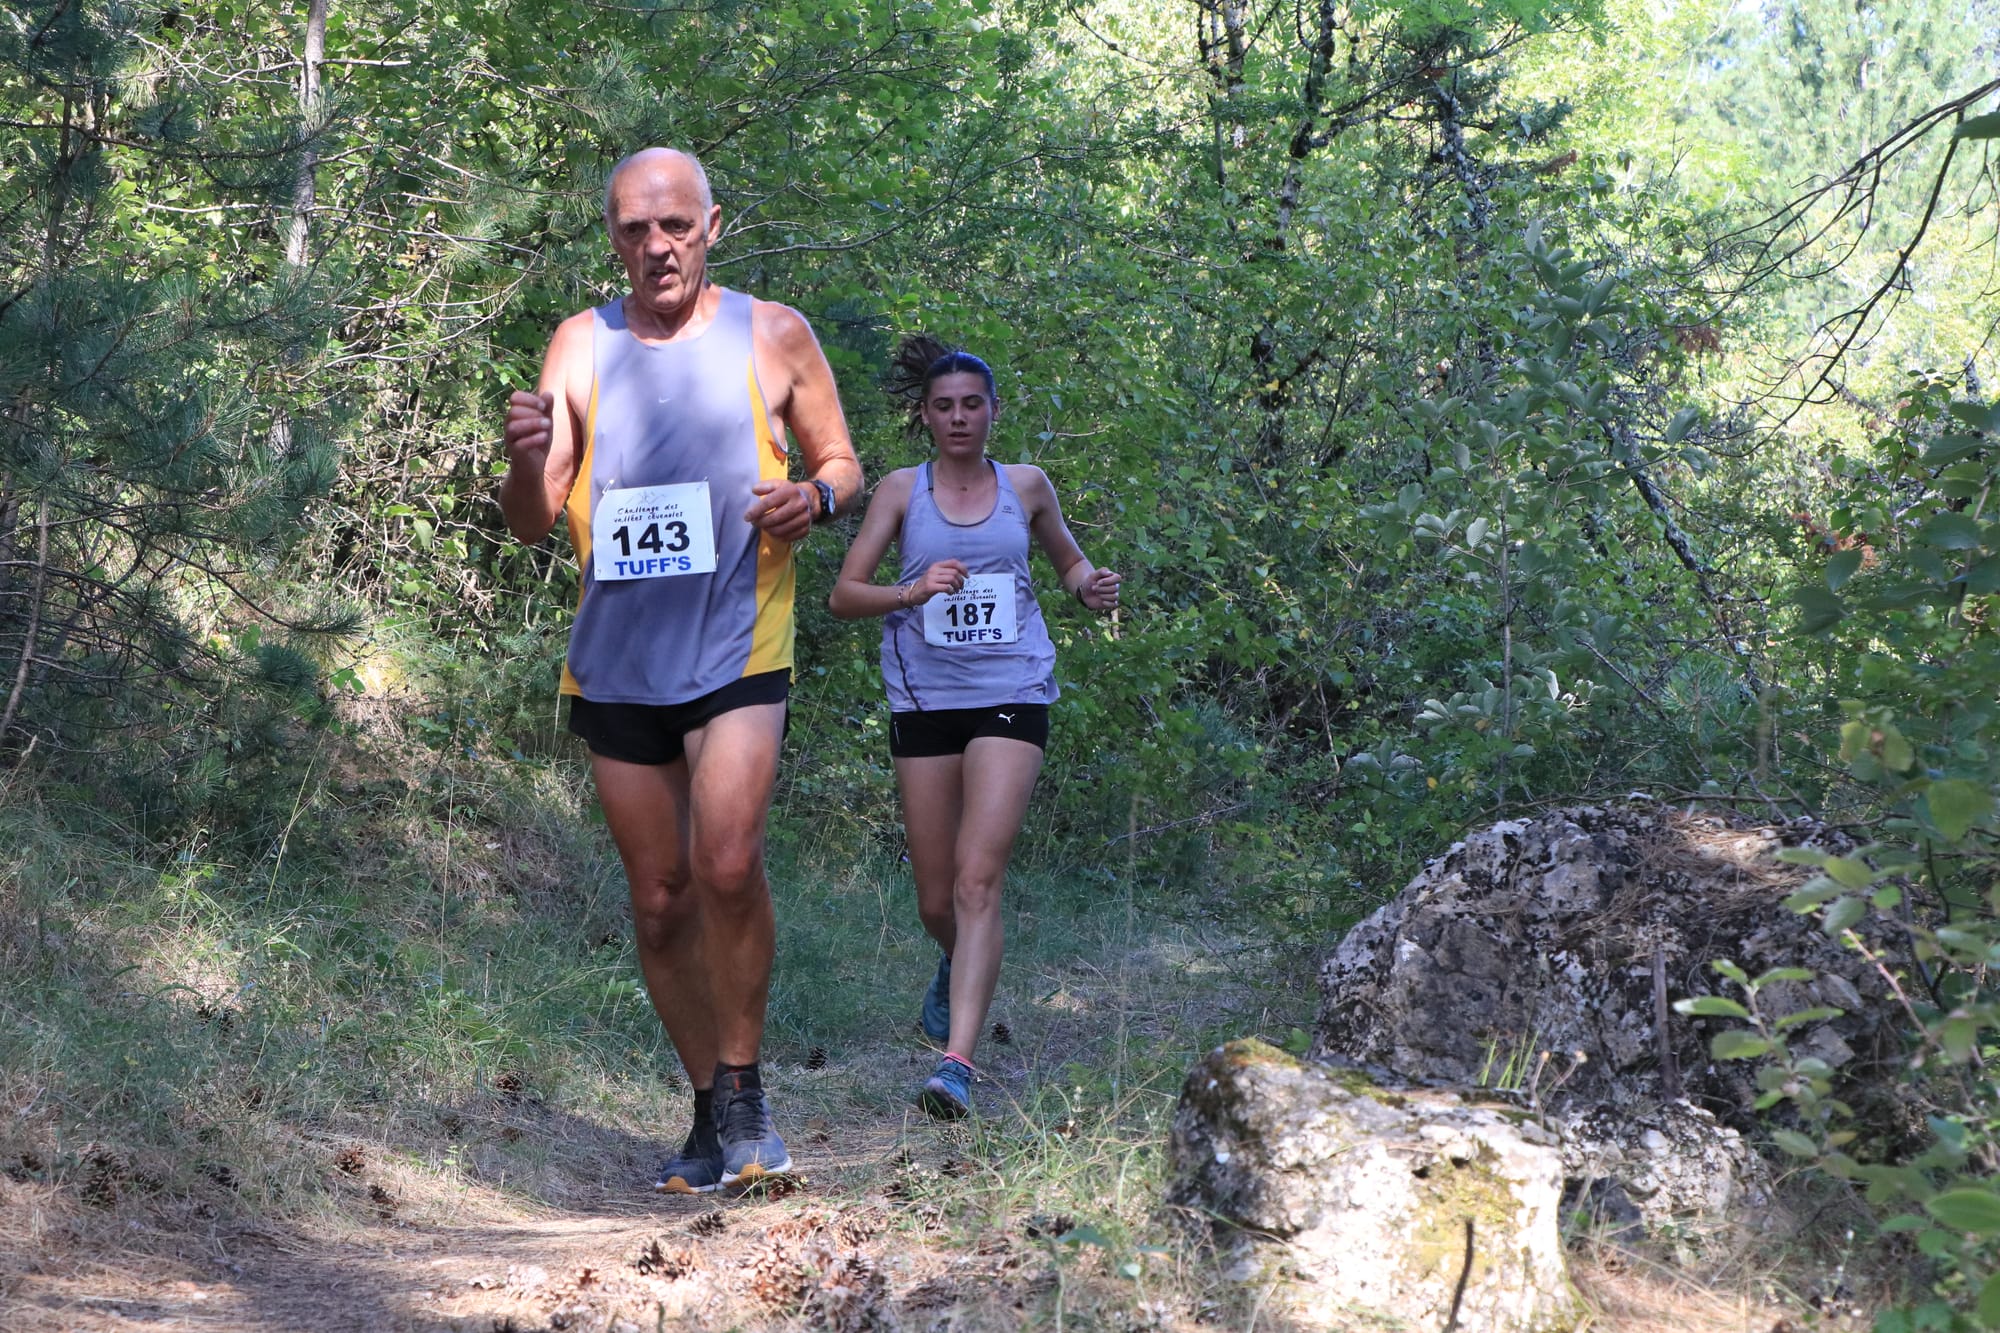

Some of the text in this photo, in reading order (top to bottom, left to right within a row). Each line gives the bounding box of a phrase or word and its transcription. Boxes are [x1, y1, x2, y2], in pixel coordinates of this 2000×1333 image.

[617, 503, 678, 515] Challenge des
[612, 521, 690, 556] 143
[614, 556, 692, 576] TUFF'S
[946, 602, 996, 627] 187
[943, 628, 1002, 643] TUFF'S
